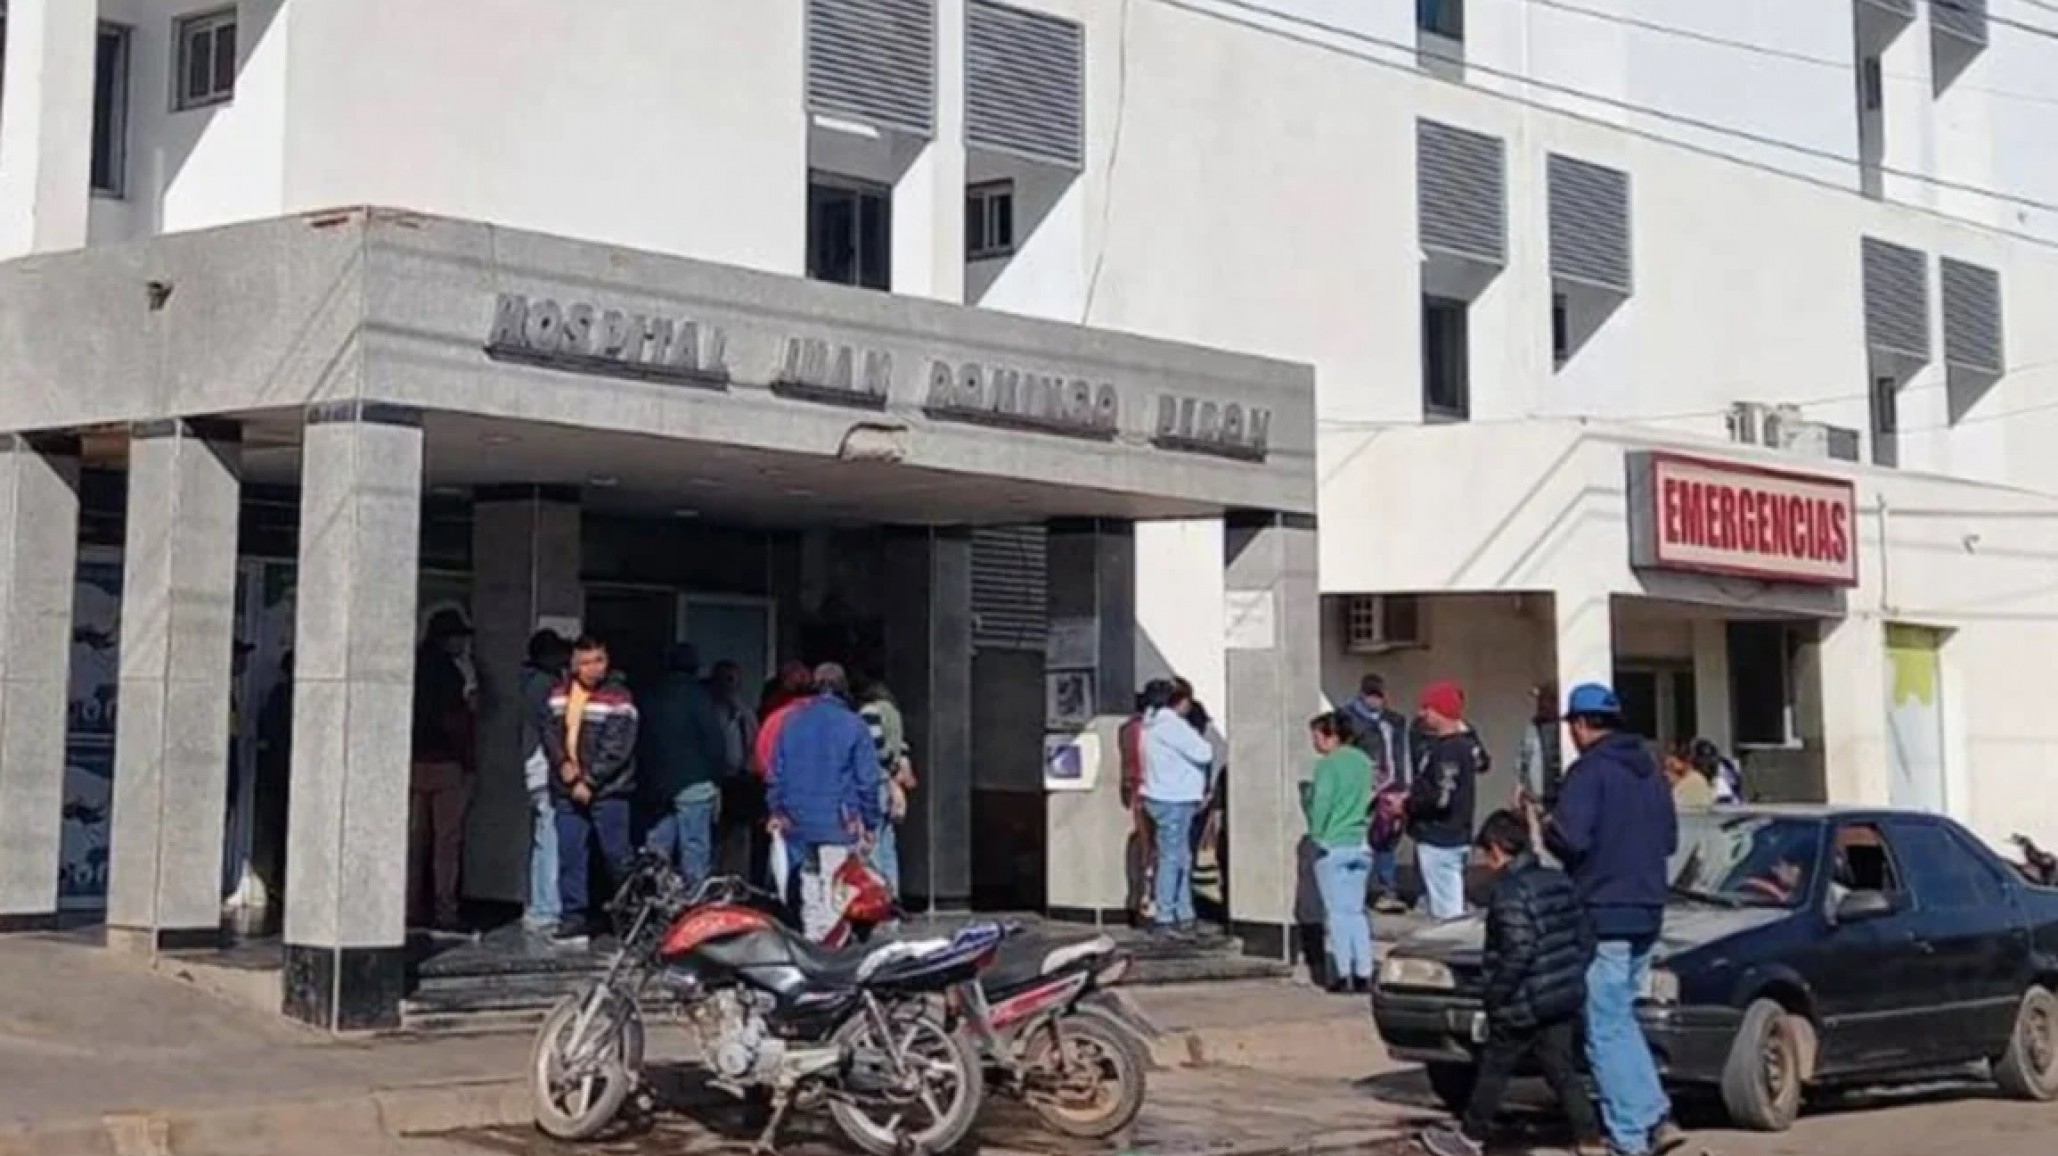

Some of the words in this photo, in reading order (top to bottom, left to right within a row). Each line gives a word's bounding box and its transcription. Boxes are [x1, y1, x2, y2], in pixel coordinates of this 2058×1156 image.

[486, 293, 729, 380] HOSPITAL
[774, 337, 892, 407] JUAN
[925, 360, 1119, 437] DOMINGO
[1664, 478, 1847, 562] EMERGENCIAS
